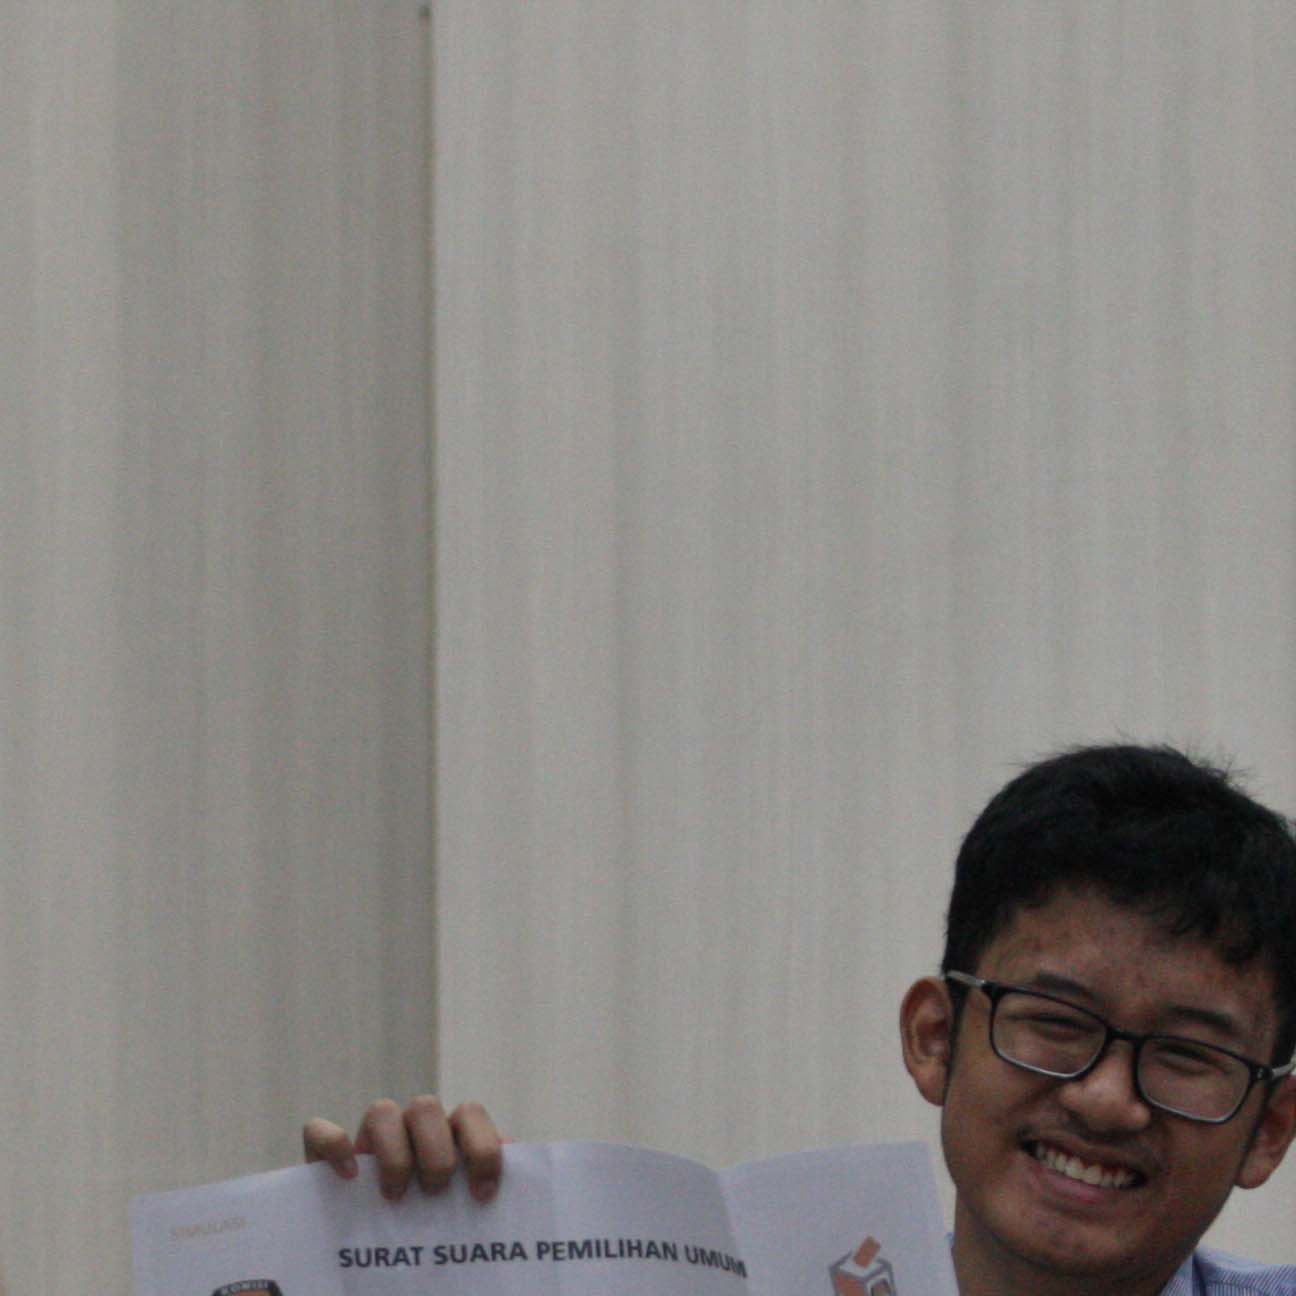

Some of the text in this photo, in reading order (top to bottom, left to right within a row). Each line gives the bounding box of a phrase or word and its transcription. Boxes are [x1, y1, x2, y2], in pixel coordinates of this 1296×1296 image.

[338, 1238, 748, 1278] SURAT SUARA PEMILIHAN UMUM
